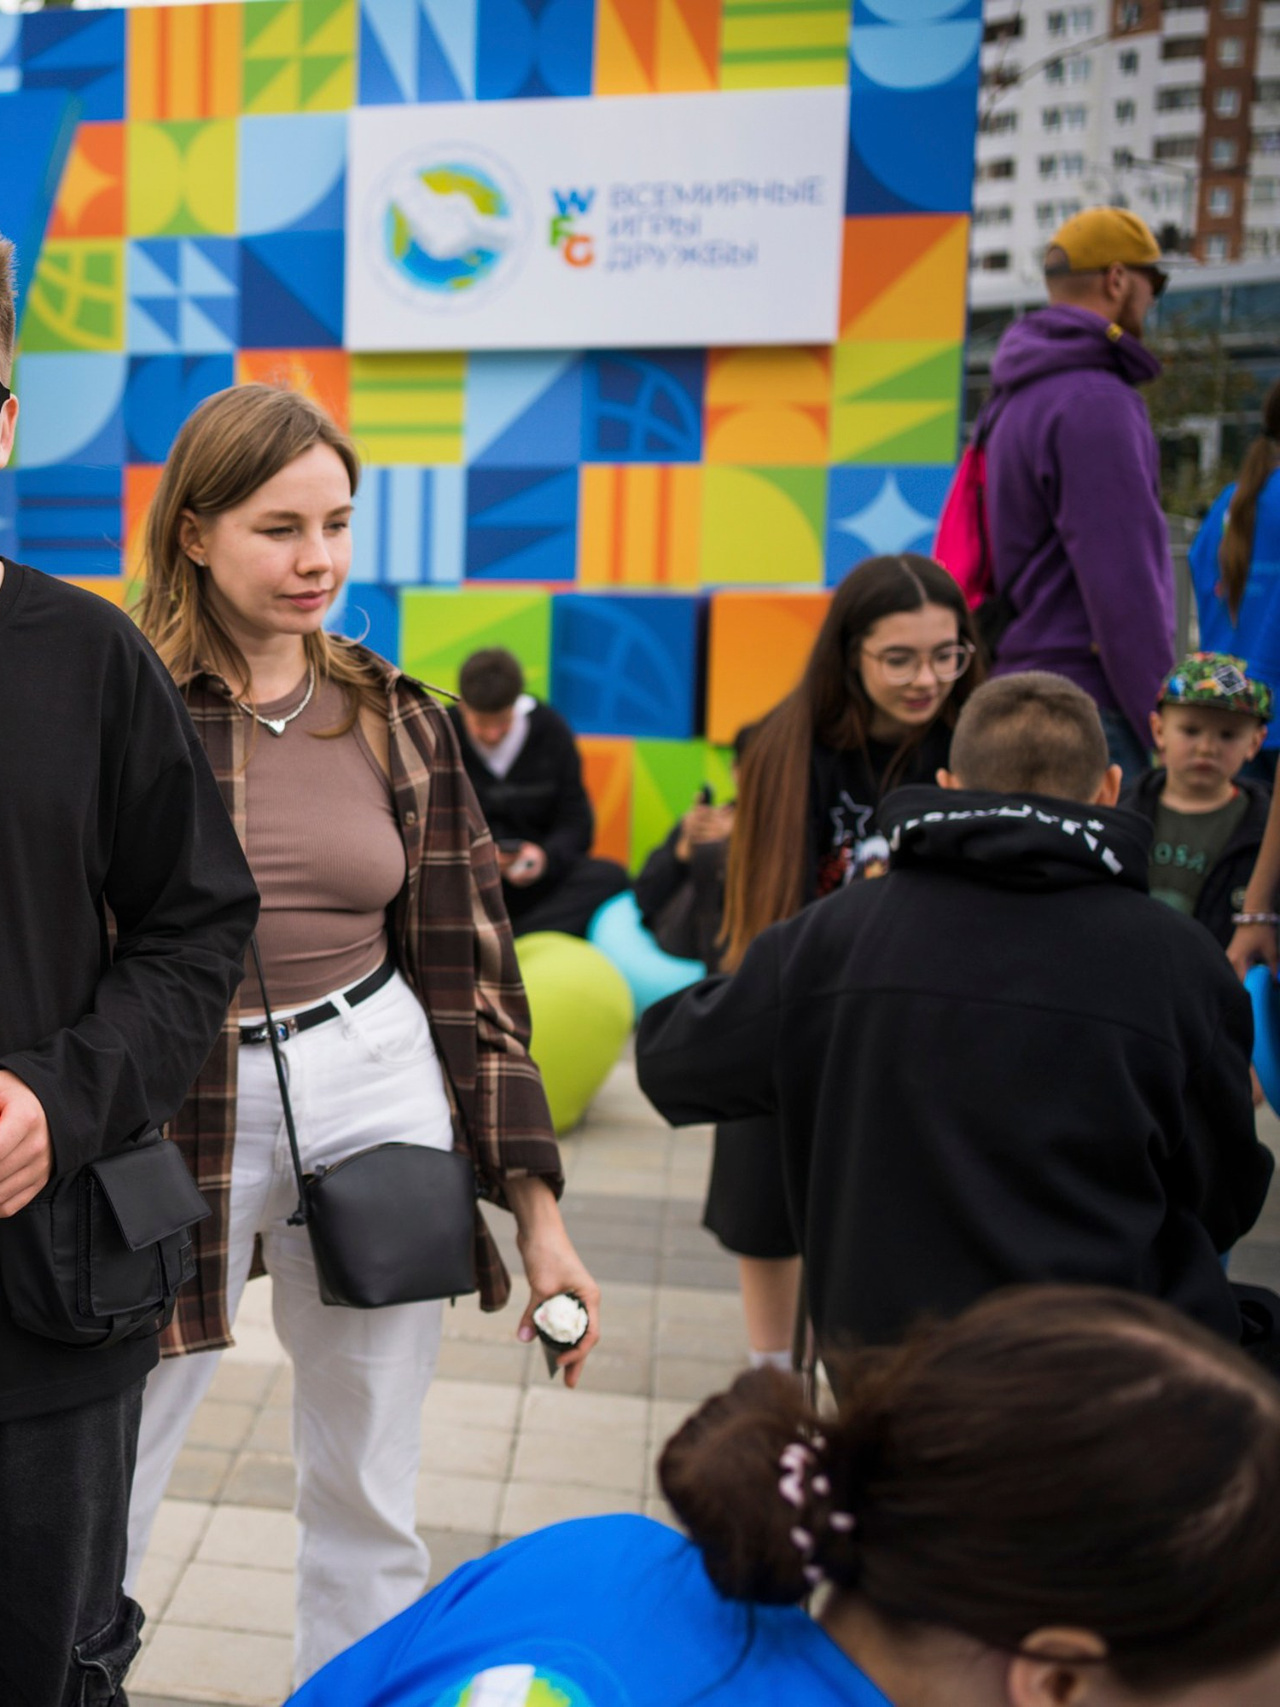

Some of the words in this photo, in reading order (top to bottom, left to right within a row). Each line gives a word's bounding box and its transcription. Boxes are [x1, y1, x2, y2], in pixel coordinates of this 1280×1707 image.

[608, 176, 824, 208] ВСЕМИРНЫЕ
[608, 213, 701, 238] ИГРЫ
[606, 240, 758, 271] ДРУЖБЫ
